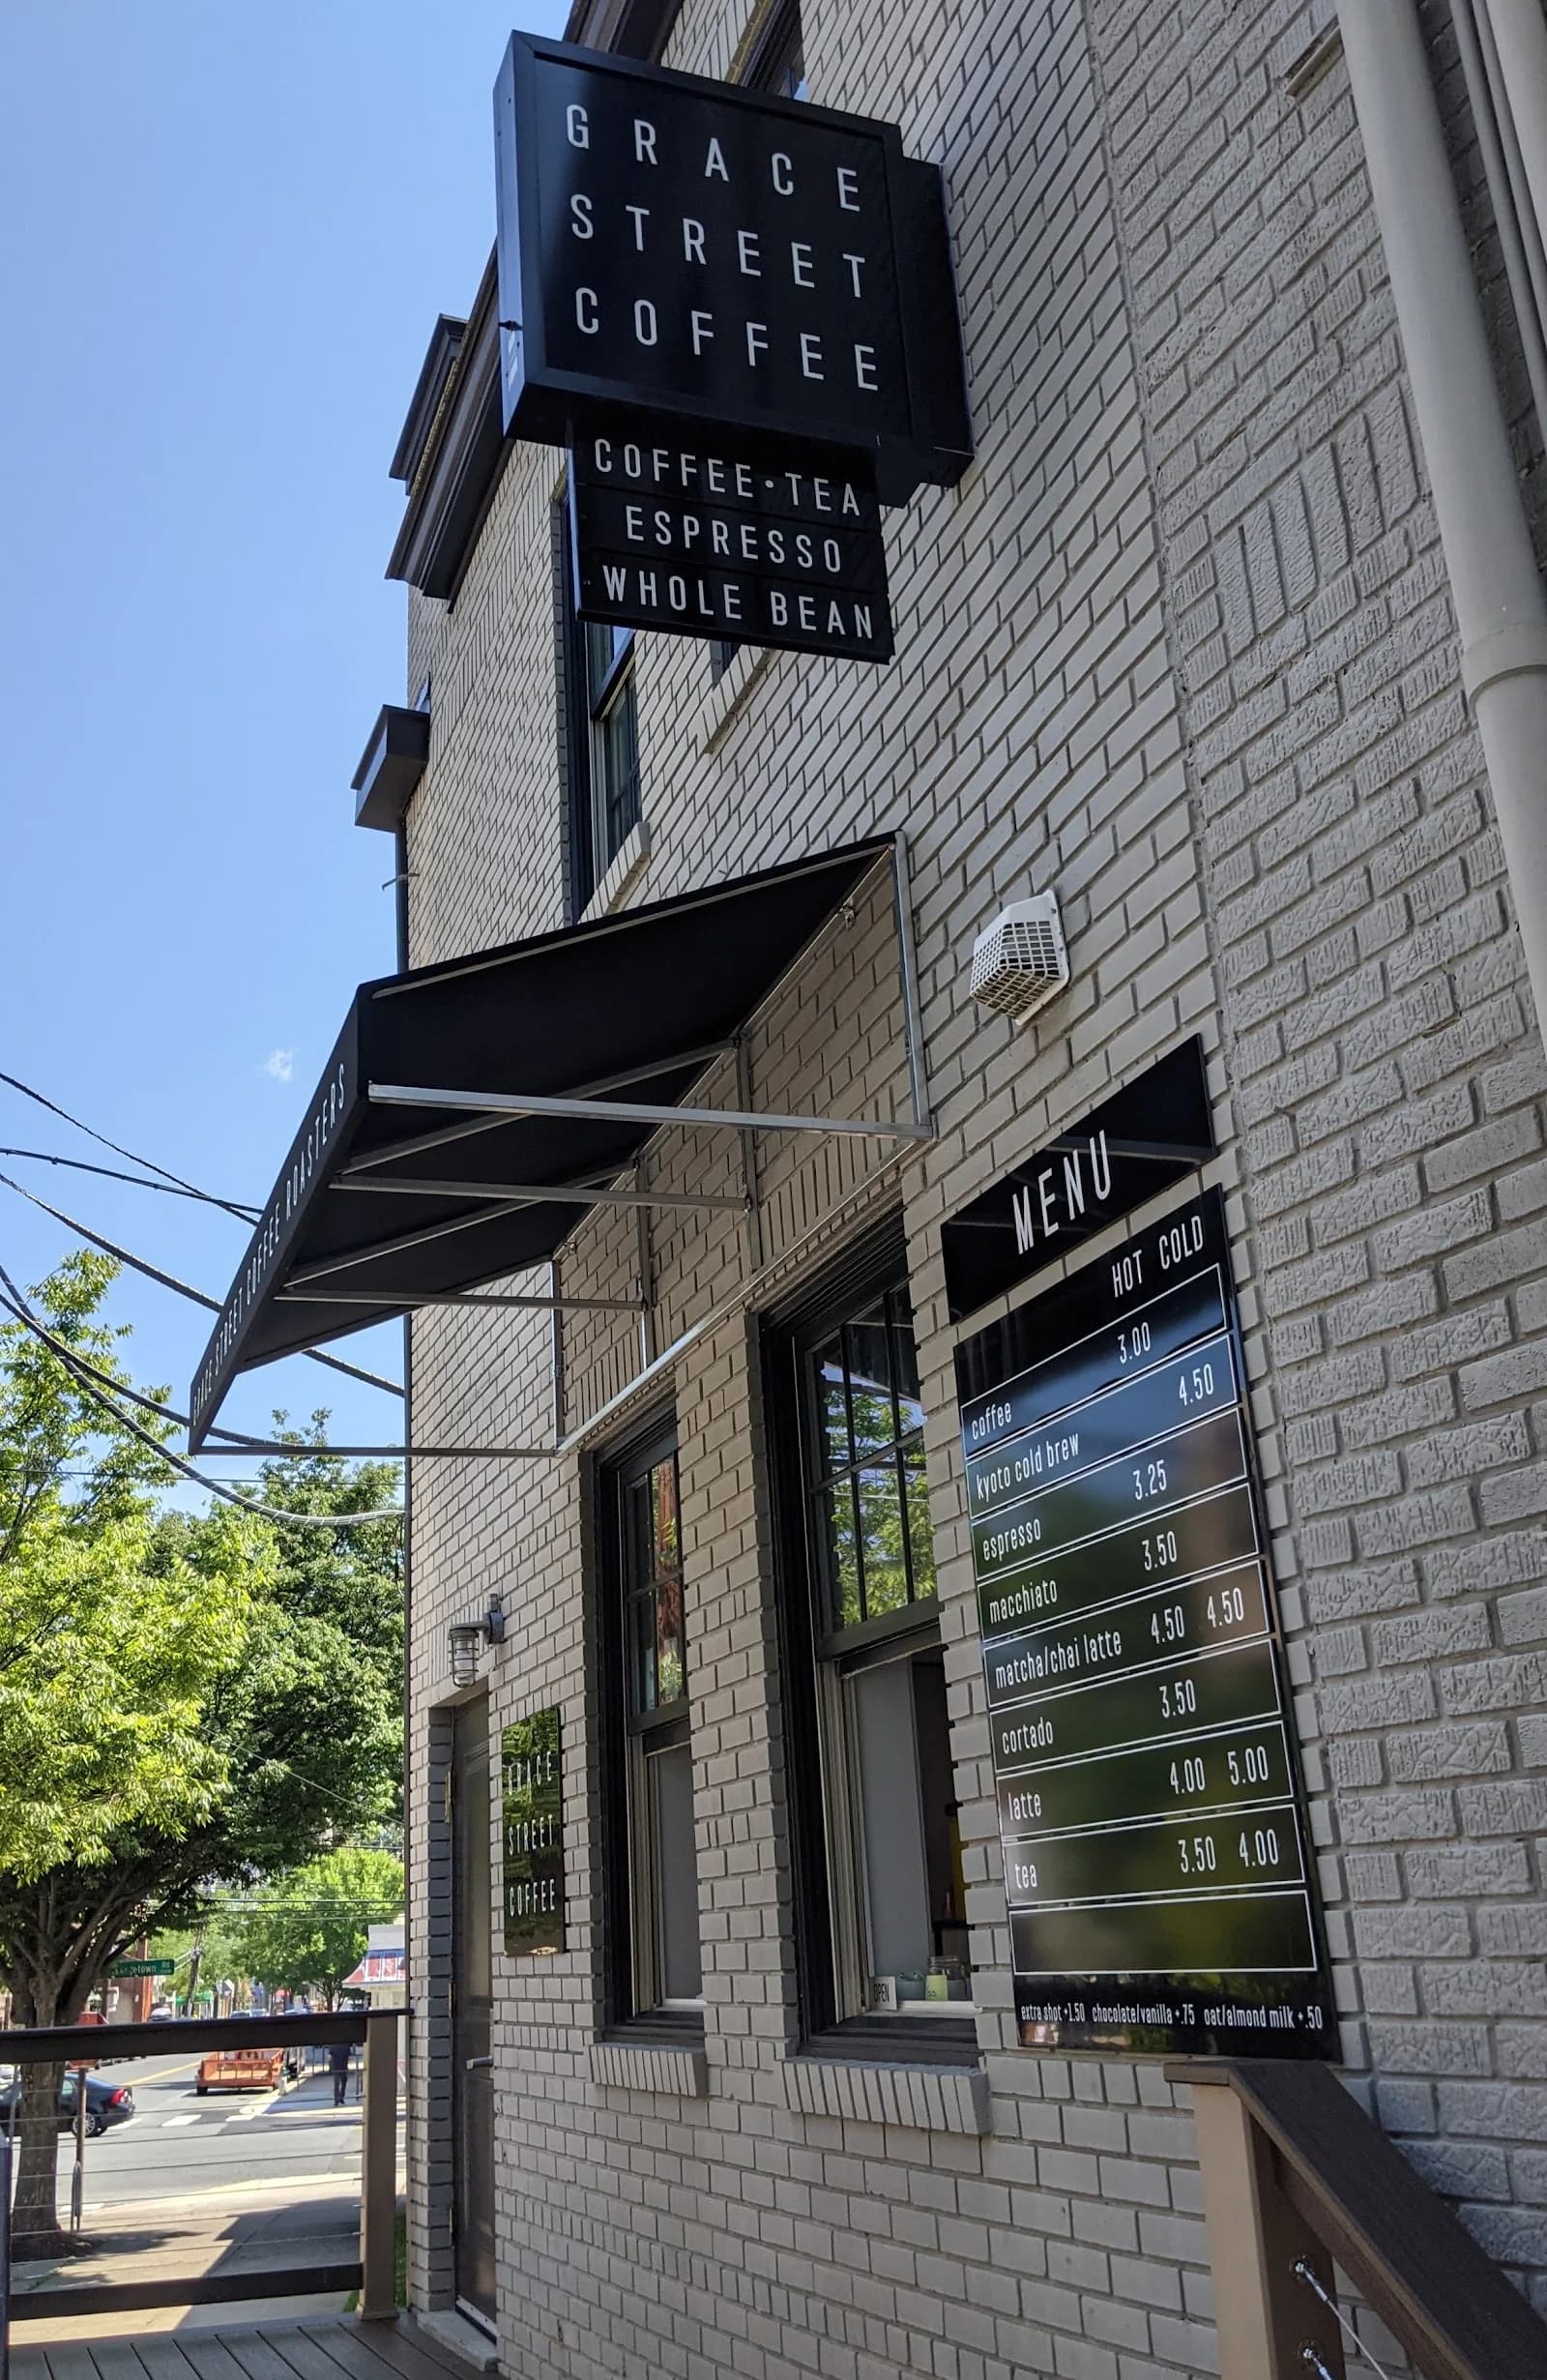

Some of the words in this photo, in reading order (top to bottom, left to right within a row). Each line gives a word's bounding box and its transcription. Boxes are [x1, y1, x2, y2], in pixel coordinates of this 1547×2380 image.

[567, 103, 861, 213] GRACE
[571, 193, 865, 299] STREET
[576, 287, 879, 391] COFFEE
[626, 506, 841, 573] ESPRESSO
[602, 564, 743, 620] WHOLE
[771, 591, 873, 639] BEAN
[215, 1286, 243, 1376] STREET
[247, 1201, 280, 1306] COFFEE
[286, 1063, 345, 1221] ROASTERS
[1012, 1129, 1112, 1255] MENU
[1112, 1249, 1143, 1298] HOT
[1158, 1215, 1205, 1270] COLD
[972, 1400, 1012, 1441] coffee
[1117, 1321, 1151, 1365] 3.00
[976, 1466, 1011, 1501] kyoto
[1014, 1449, 1042, 1483] cold
[1046, 1432, 1079, 1468] brew
[1179, 1363, 1214, 1407] 4.50
[982, 1517, 1041, 1563] espresso
[1132, 1459, 1167, 1501] 3.25
[989, 1578, 1058, 1624] macchiato
[1141, 1531, 1178, 1572] 3.50
[995, 1634, 1081, 1690] matcha/chai
[1085, 1630, 1123, 1664] latte
[1151, 1604, 1185, 1645] 4.50
[1207, 1587, 1244, 1629] 4.50
[1002, 1718, 1054, 1755] cortado
[1159, 1679, 1197, 1719] 3.50
[508, 1750, 552, 1803] GRACE
[1007, 1792, 1041, 1821] latte
[1169, 1756, 1207, 1795] 4.00
[1227, 1745, 1269, 1786] 5.00
[509, 1814, 554, 1856] STREET
[1015, 1863, 1037, 1889] tea
[1178, 1836, 1216, 1873] 3.50
[1239, 1829, 1279, 1868] 4.00
[510, 1879, 555, 1917] COFFEE
[1020, 2005, 1042, 2021] extra
[1043, 2004, 1062, 2022] shot
[1092, 2002, 1173, 2025] chocolate/vanilla
[1204, 2005, 1267, 2027] oat/almond
[1270, 2005, 1295, 2029] milk
